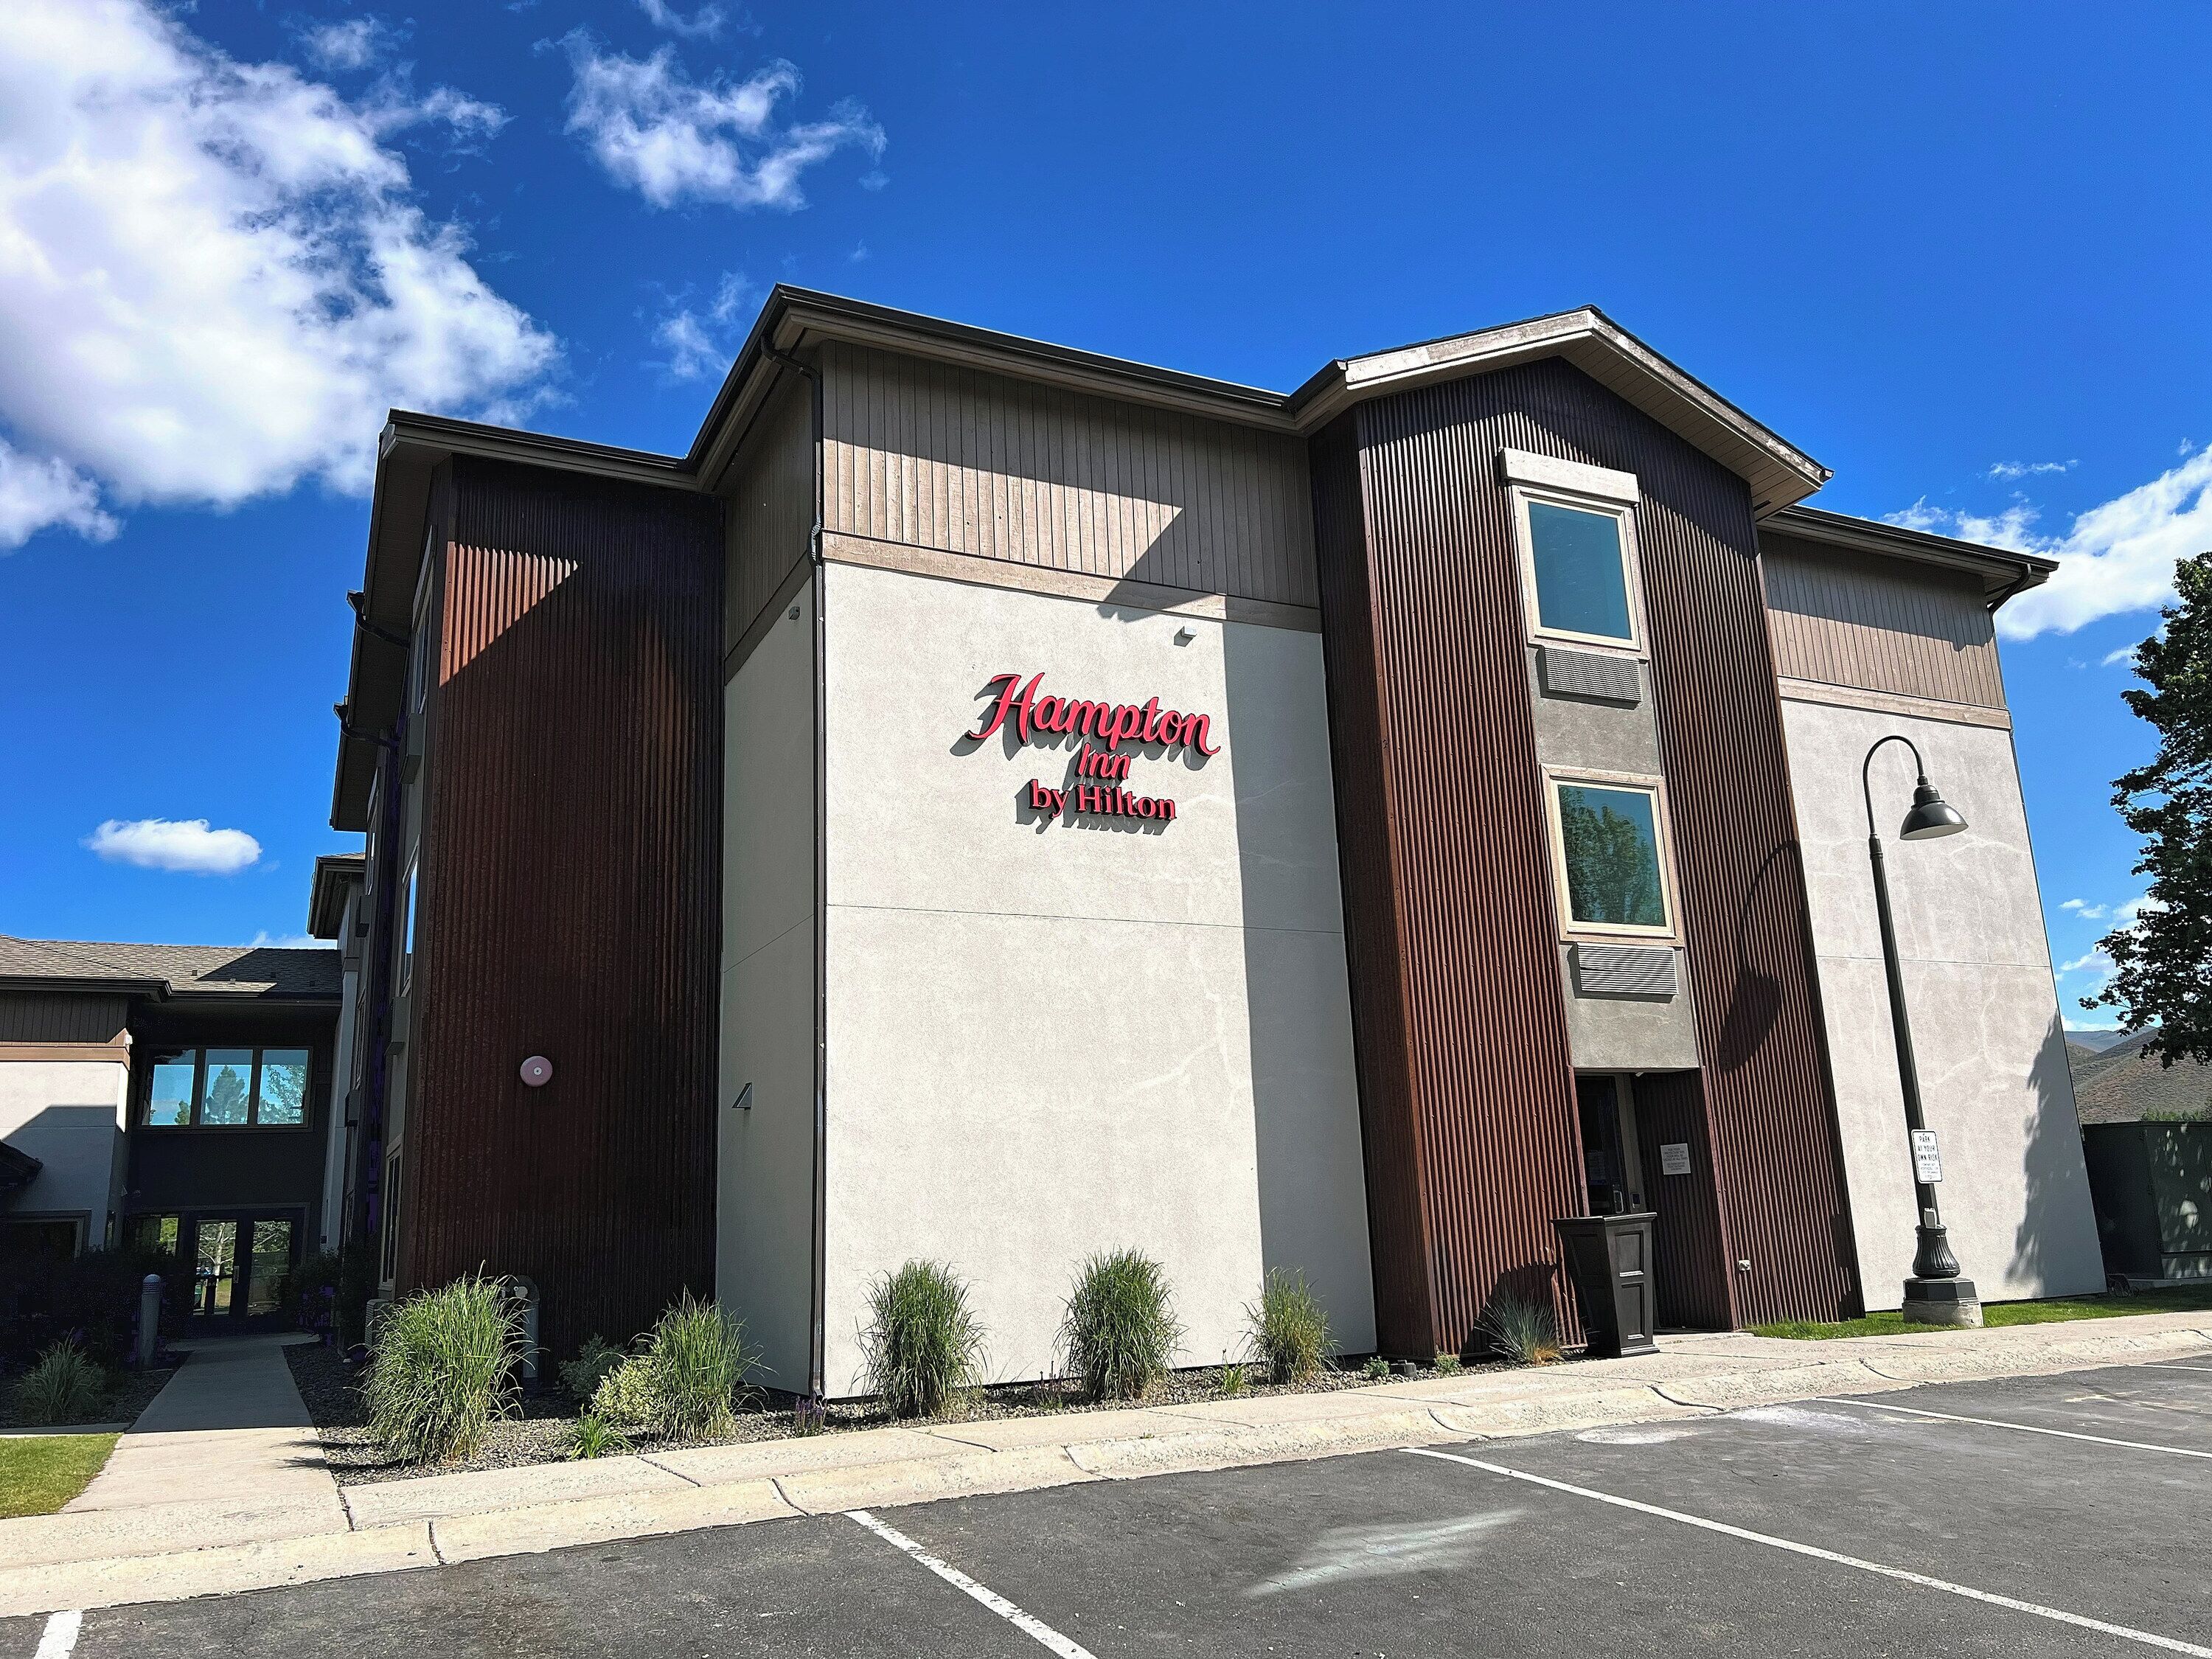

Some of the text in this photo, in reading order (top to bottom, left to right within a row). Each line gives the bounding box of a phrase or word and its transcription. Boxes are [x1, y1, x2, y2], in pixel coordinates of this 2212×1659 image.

[965, 672, 1221, 756] Hampton
[1076, 743, 1131, 780] Inn
[1029, 779, 1178, 821] by Hilton
